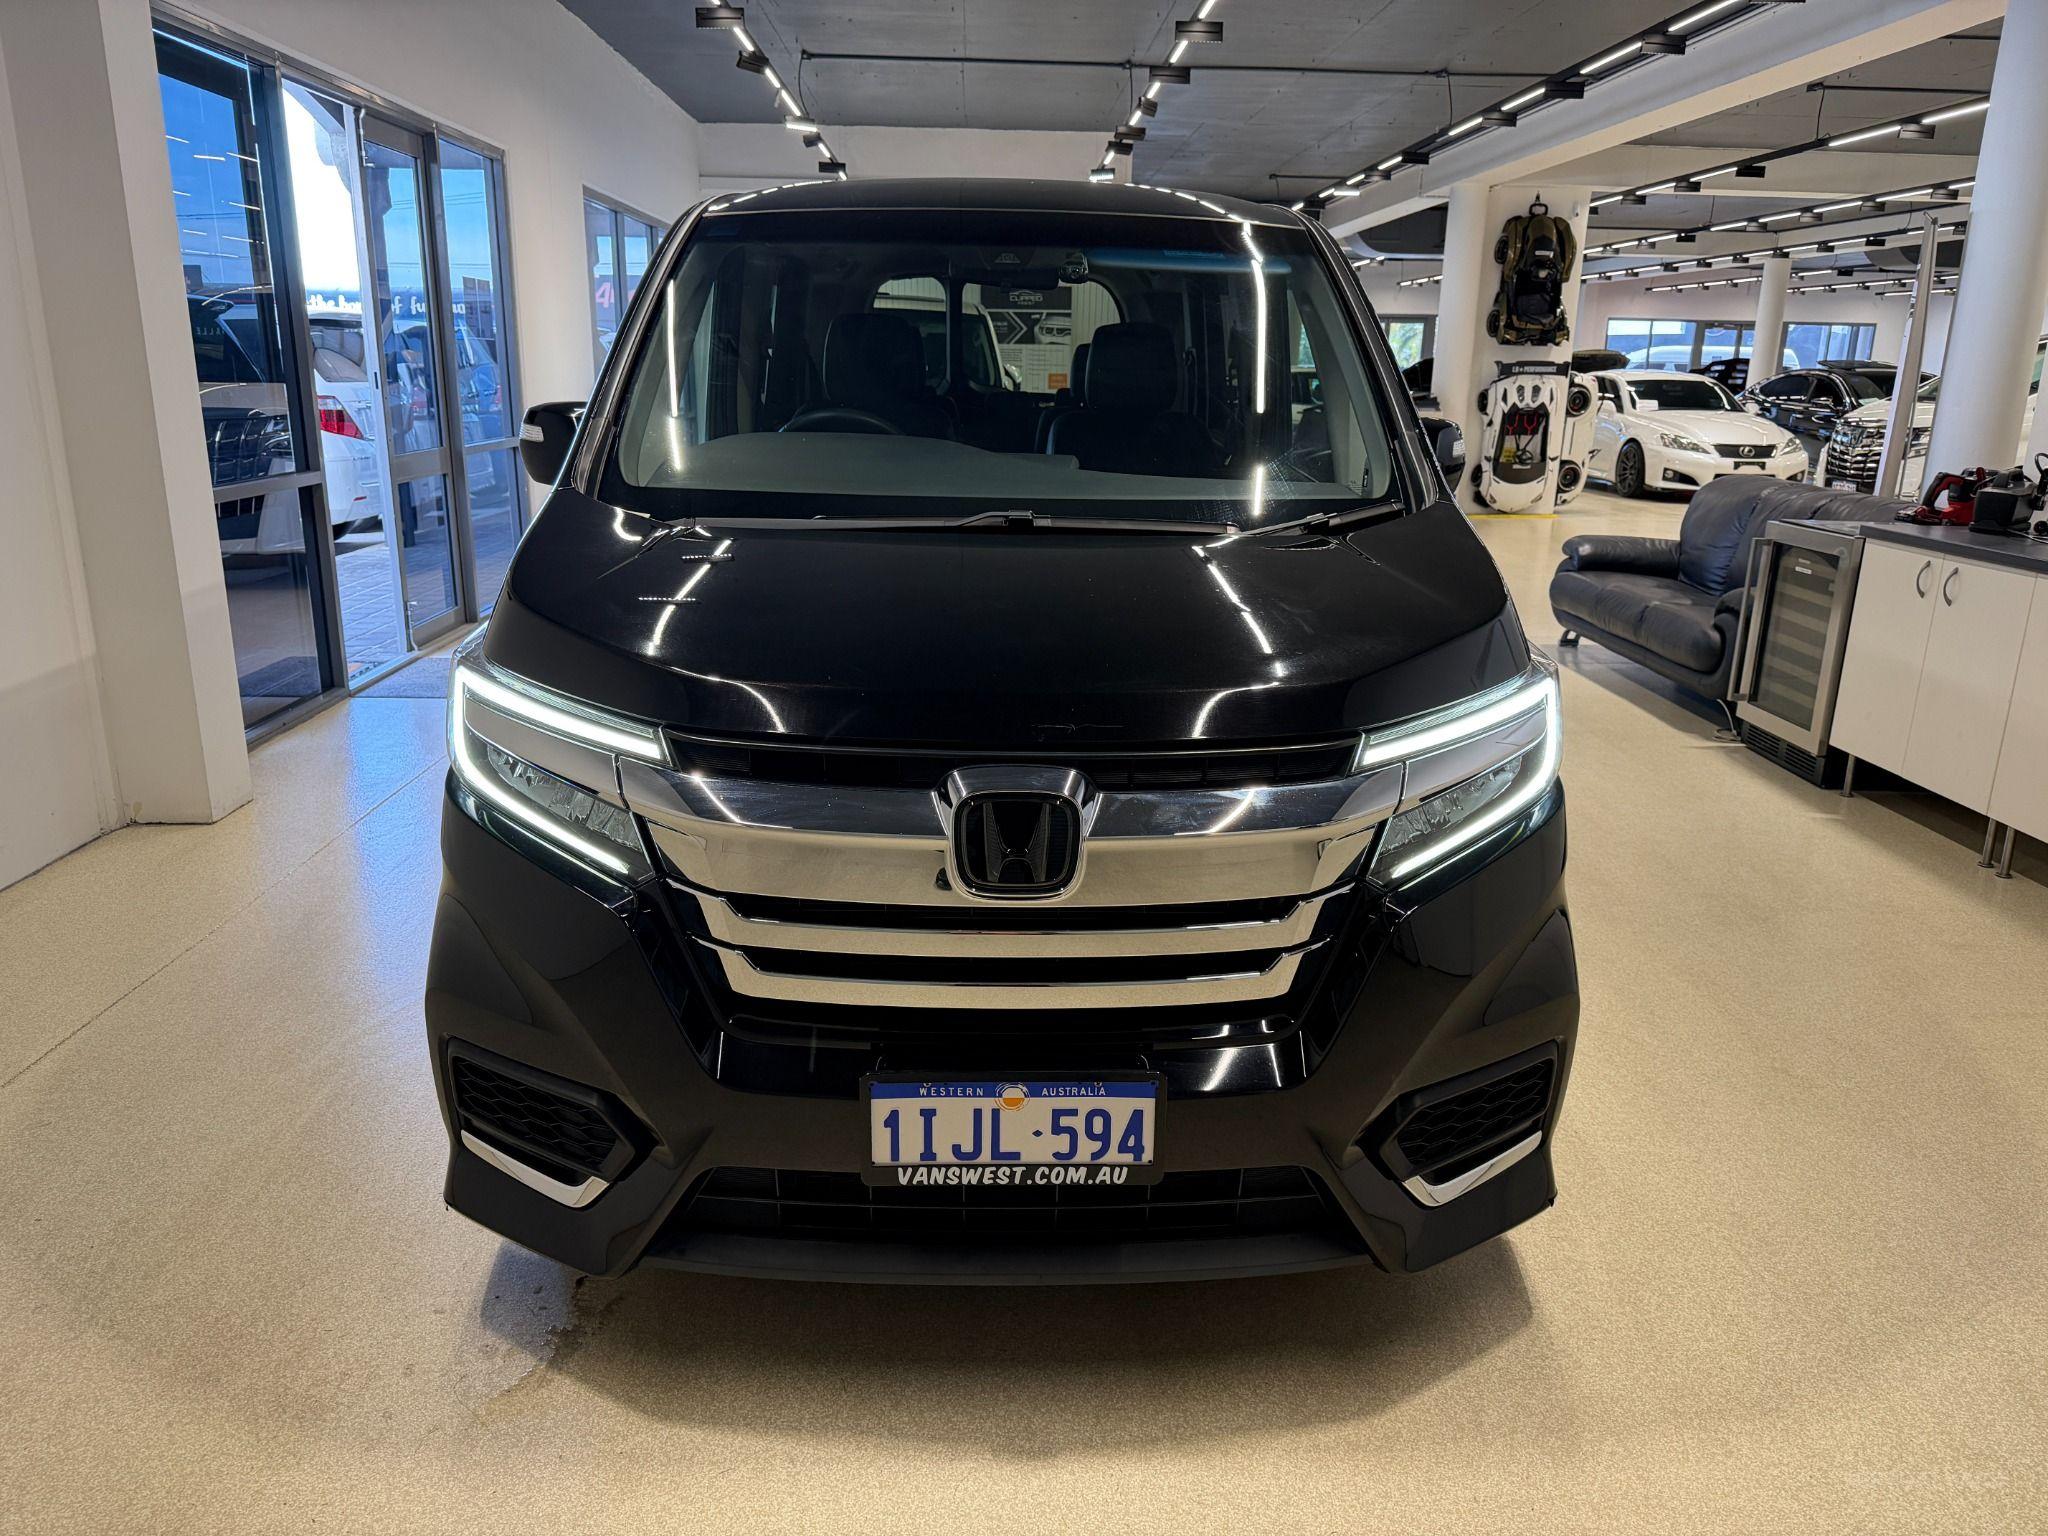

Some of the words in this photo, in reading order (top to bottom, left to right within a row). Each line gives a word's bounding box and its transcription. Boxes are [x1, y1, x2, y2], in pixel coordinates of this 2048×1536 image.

[919, 1086, 985, 1096] WESTERN
[1041, 1085, 1107, 1096] AUSTRALIA
[897, 1166, 1129, 1186] VANSWEST.COM.AU
